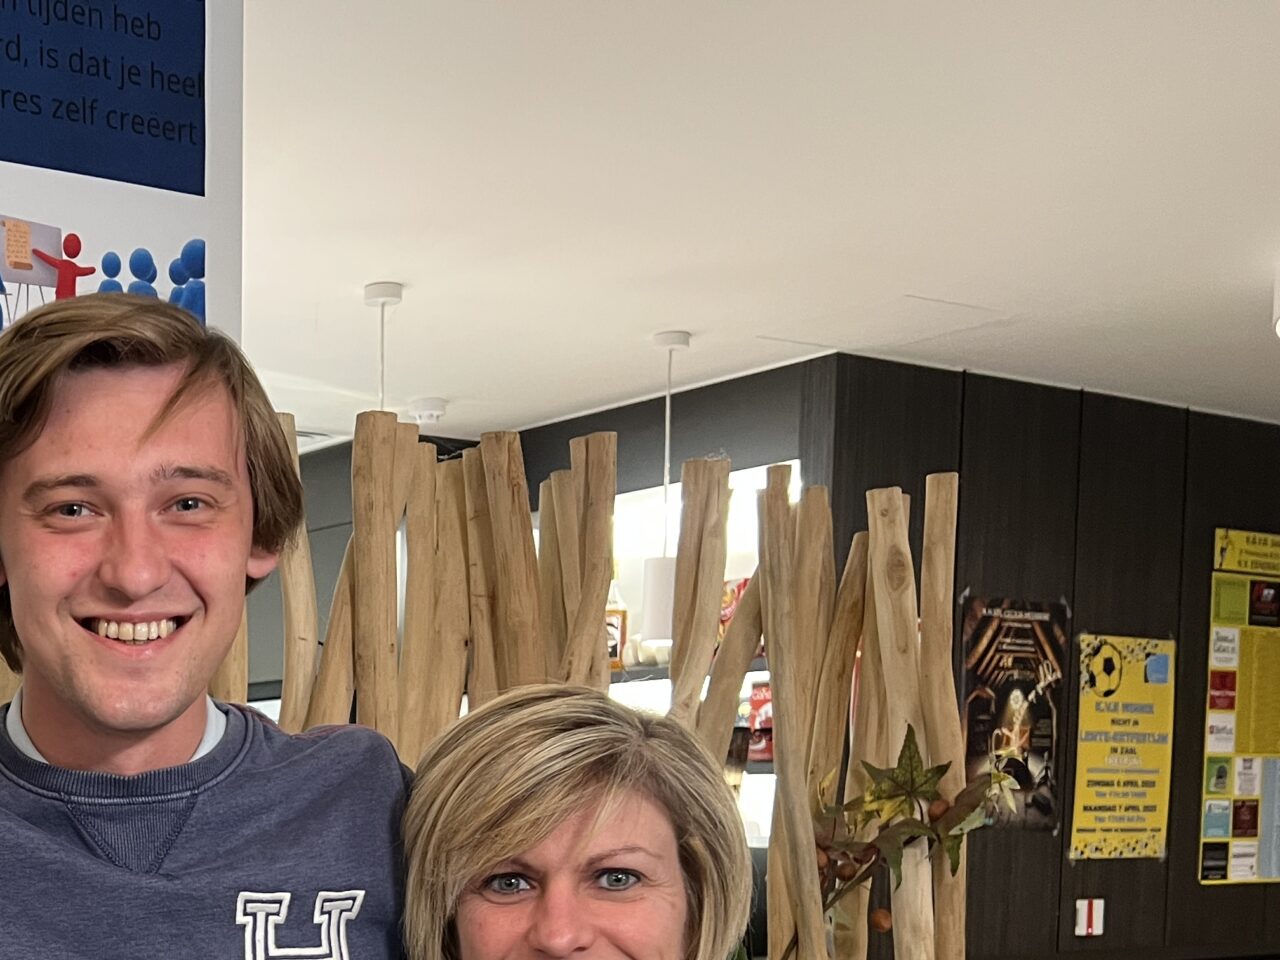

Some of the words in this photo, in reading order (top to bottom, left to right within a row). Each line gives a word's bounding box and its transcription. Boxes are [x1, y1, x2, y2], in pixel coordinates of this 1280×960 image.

[27, 0, 103, 30] tijden
[113, 4, 161, 41] heb
[39, 39, 59, 69] is
[68, 47, 111, 80] dat
[117, 56, 142, 90] je
[150, 60, 205, 99] heel
[51, 96, 99, 125] zelf
[106, 109, 197, 146] creëert
